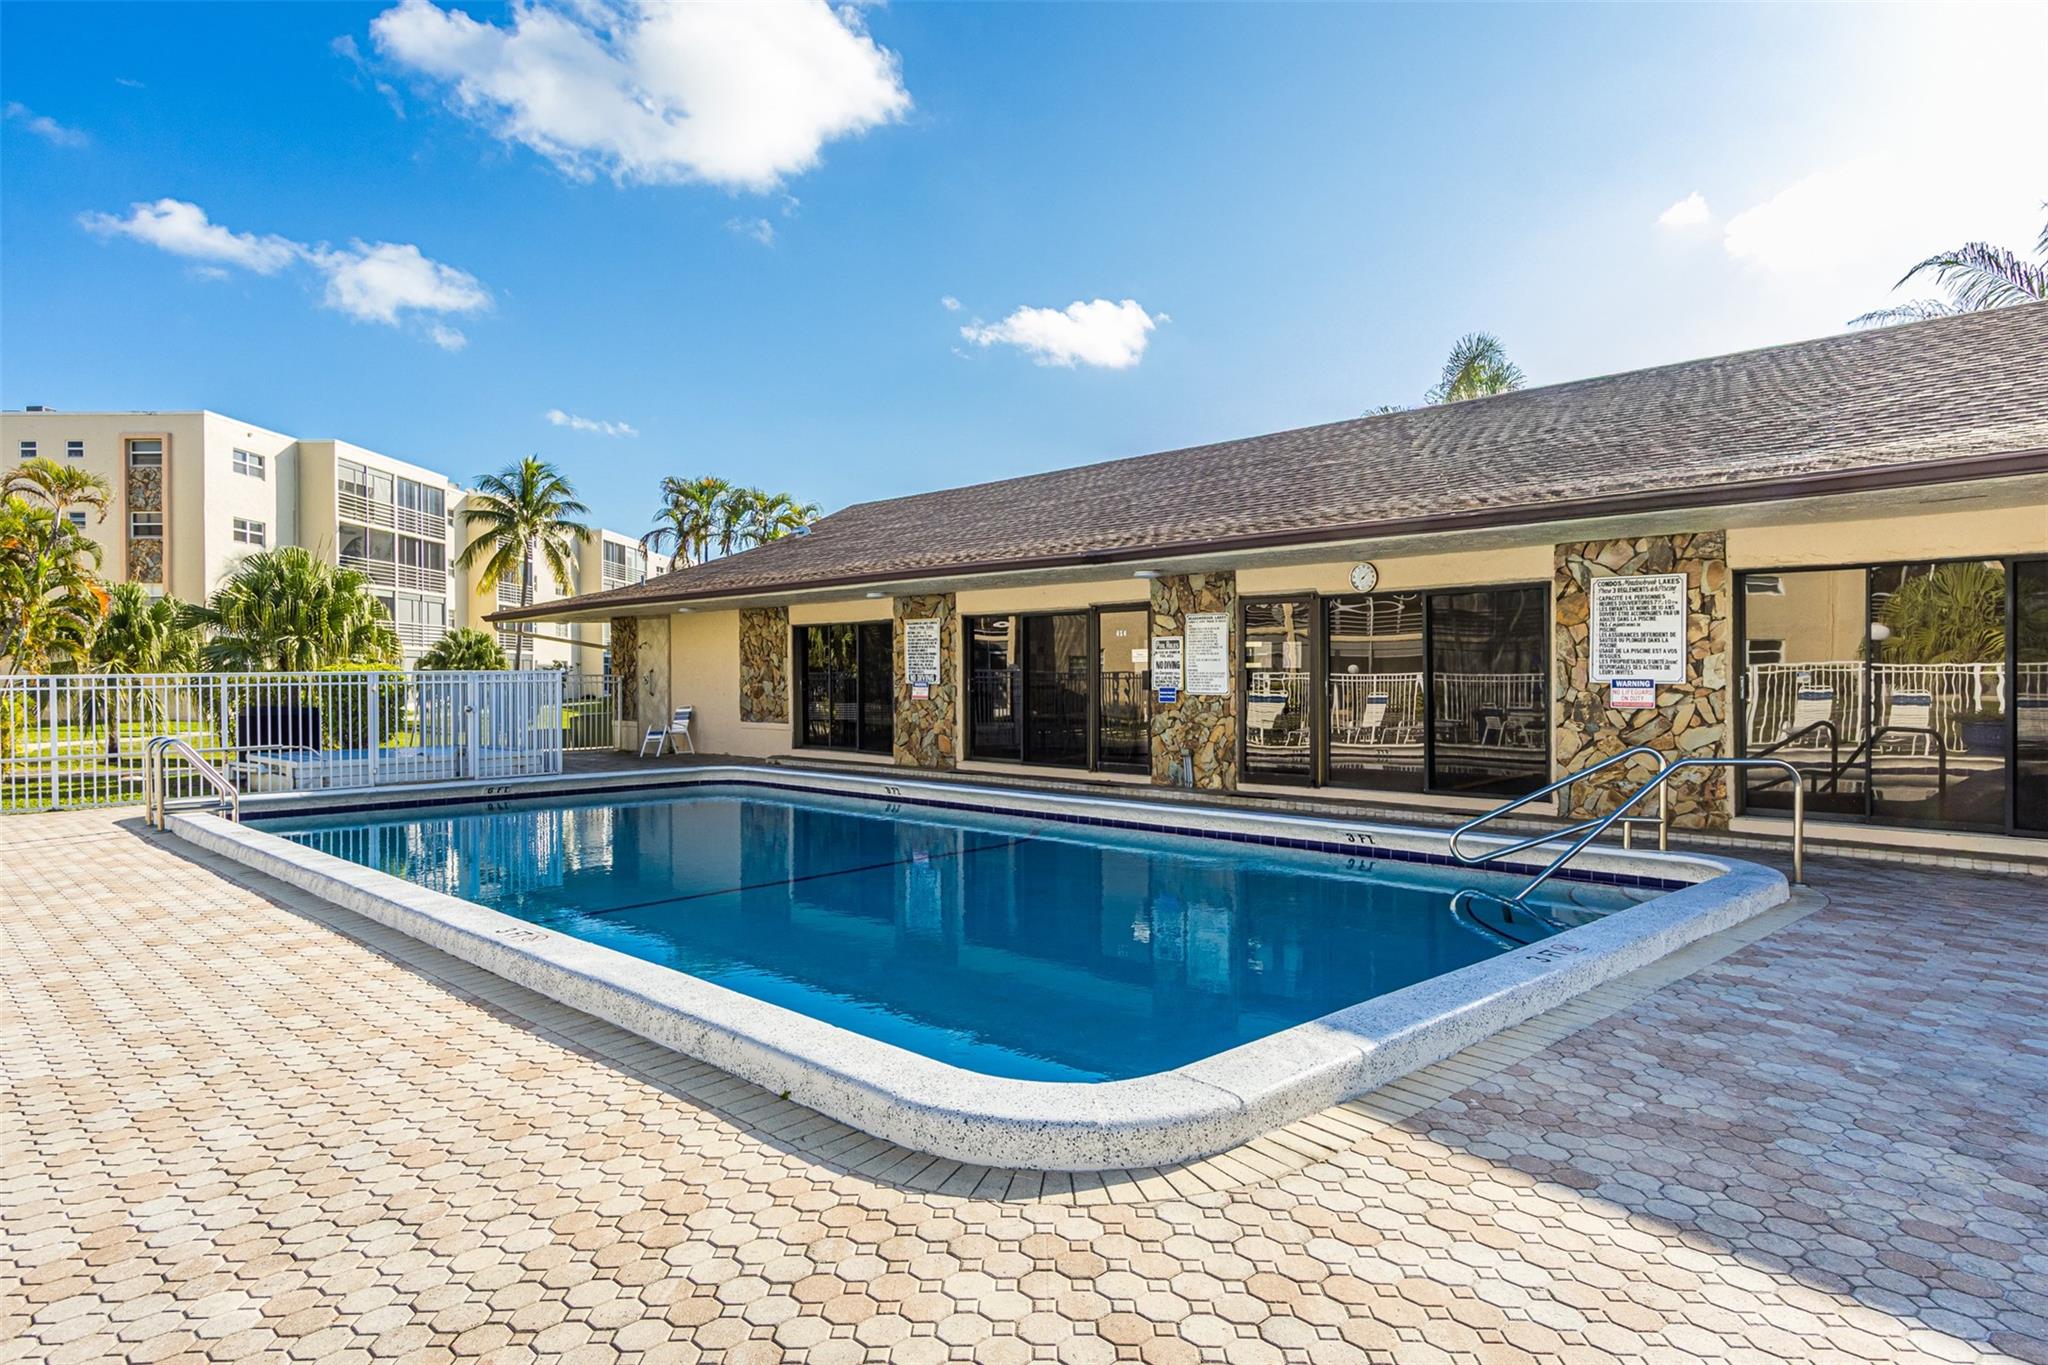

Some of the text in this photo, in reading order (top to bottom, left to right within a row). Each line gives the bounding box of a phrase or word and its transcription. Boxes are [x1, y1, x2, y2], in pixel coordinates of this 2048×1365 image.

[1156, 660, 1180, 669] NO DIVING
[1615, 680, 1651, 688] WARNING
